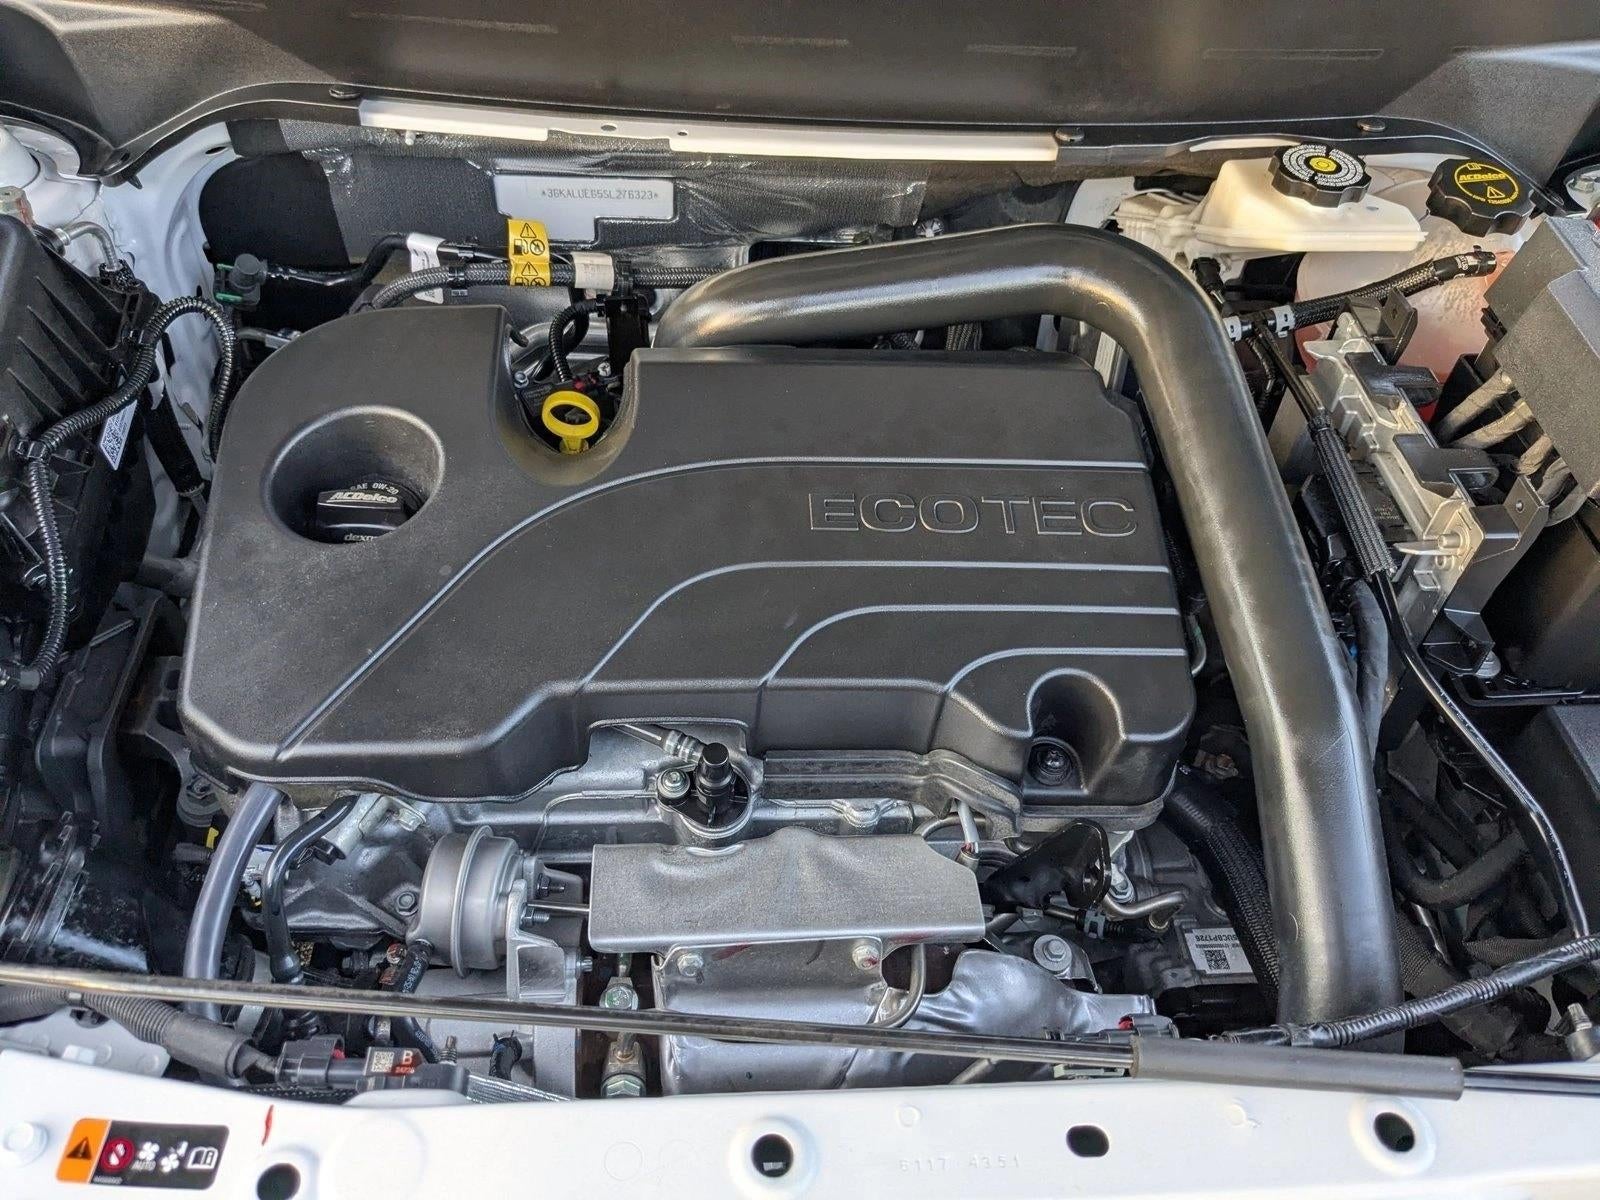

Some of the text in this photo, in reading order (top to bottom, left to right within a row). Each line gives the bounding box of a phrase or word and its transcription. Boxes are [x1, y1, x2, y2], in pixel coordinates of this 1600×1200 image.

[1459, 172, 1507, 184] ACDelco
[326, 491, 398, 504] ACDelco
[808, 492, 1137, 537] ECOTEC
[131, 1158, 157, 1172] AUTO
